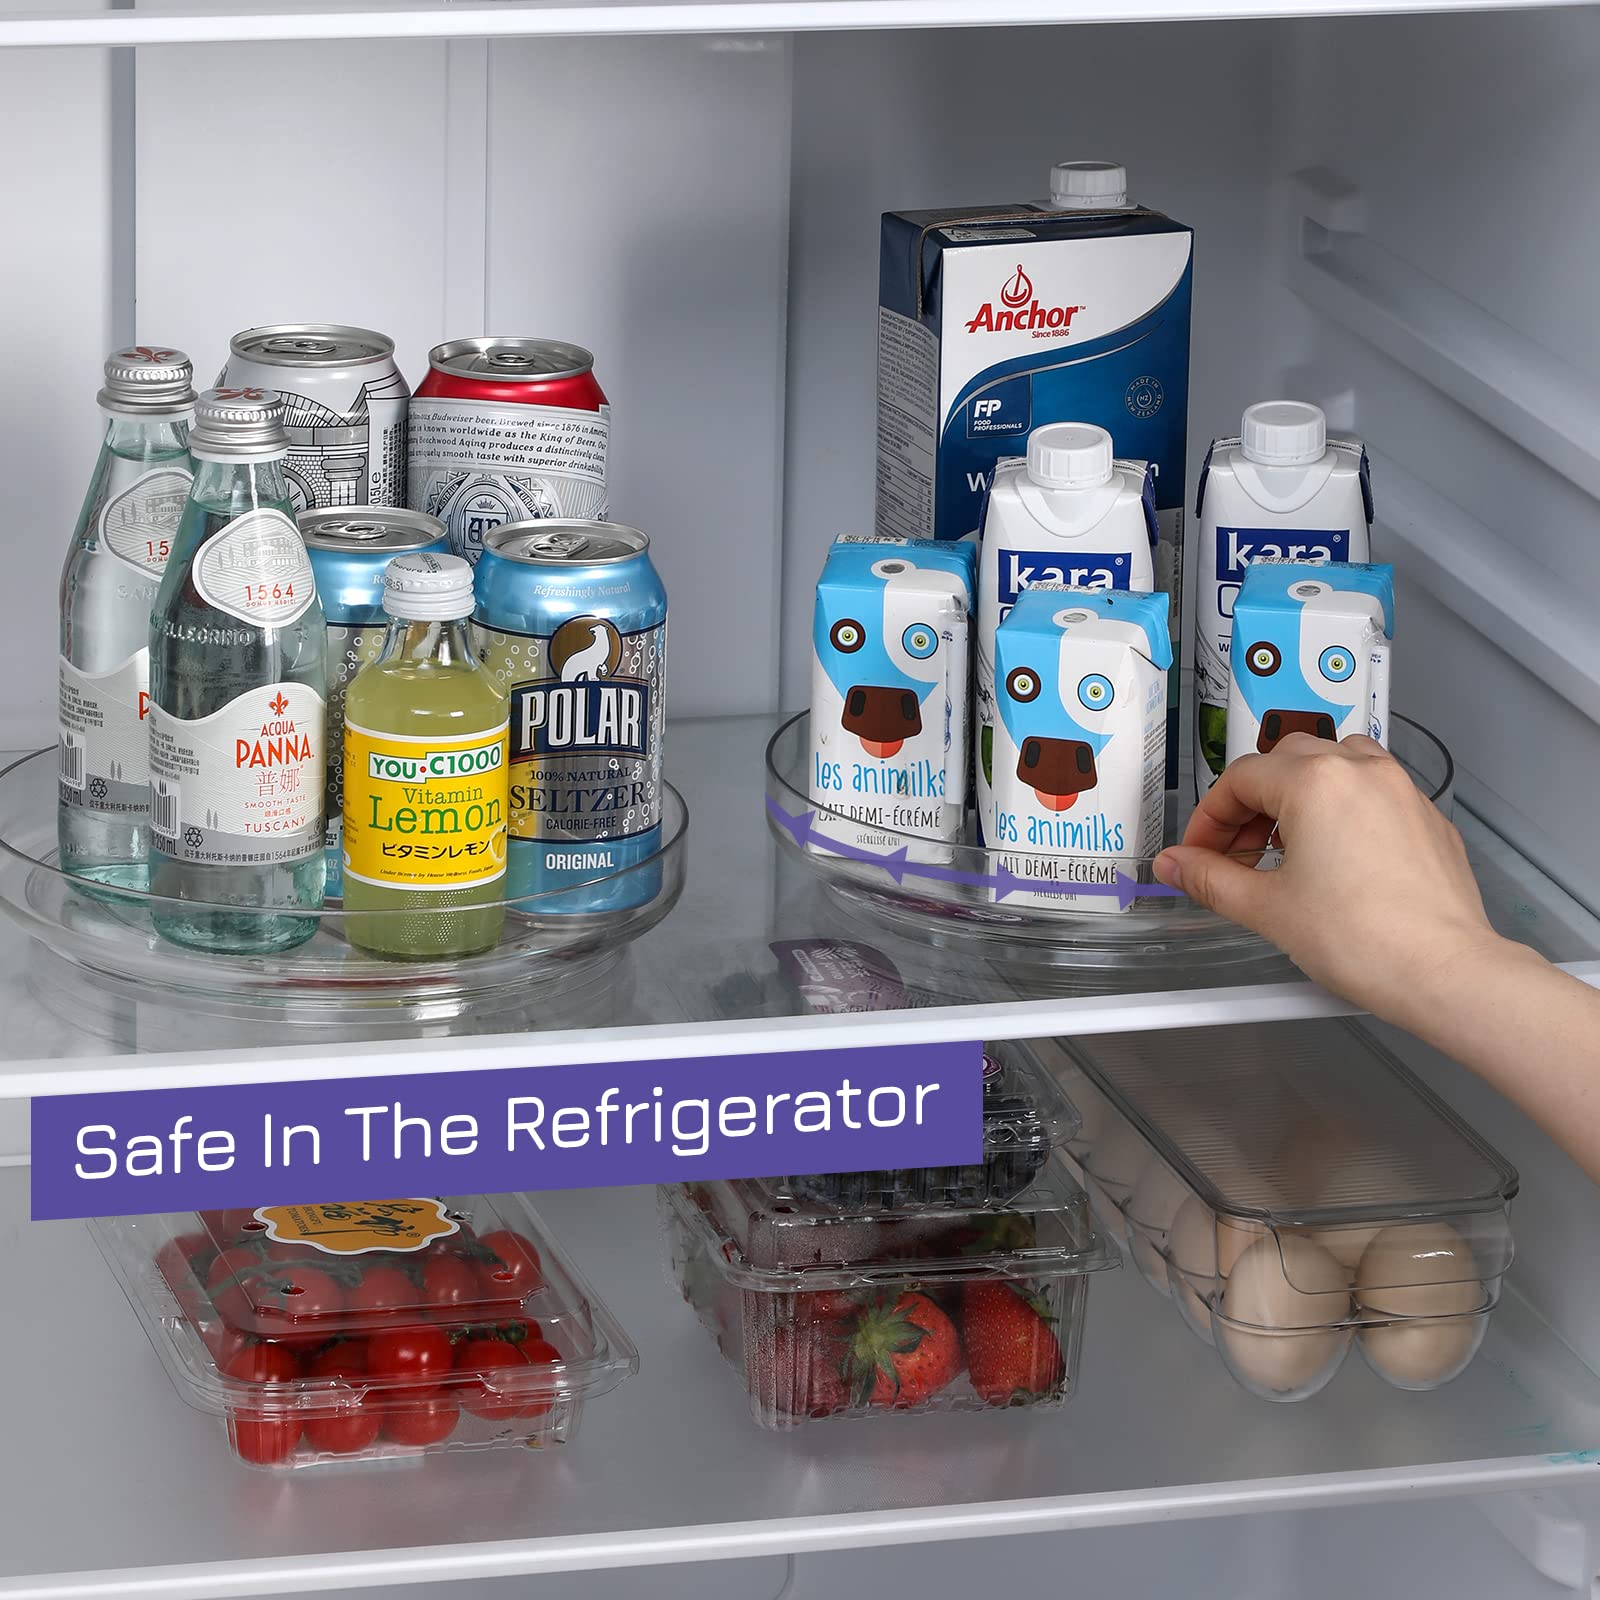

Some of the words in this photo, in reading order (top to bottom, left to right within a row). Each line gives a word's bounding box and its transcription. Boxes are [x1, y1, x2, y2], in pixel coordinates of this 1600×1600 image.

[974, 400, 1002, 417] FP
[432, 413, 473, 422] Budweiser
[475, 416, 497, 425] beer.
[561, 424, 580, 432] 1876
[581, 425, 588, 433] in
[974, 423, 1022, 431] PROFESSIONALS
[423, 424, 447, 433] known
[450, 426, 501, 437] worldwide
[520, 431, 537, 440] the
[540, 433, 562, 443] King
[565, 436, 575, 445] of
[576, 437, 596, 448] Beers.
[419, 437, 456, 445] Beechwood
[459, 438, 486, 448] Aging
[489, 442, 534, 452] produces
[545, 445, 592, 459] distinctively
[476, 452, 501, 461] taste
[503, 454, 525, 463] with
[528, 457, 567, 466] superior
[517, 490, 538, 516] EUROPE
[146, 541, 169, 556] 15
[1008, 555, 1114, 594] kara
[245, 584, 294, 601] 1564
[533, 584, 594, 598] Refreshingly
[598, 581, 631, 596] Natural
[261, 720, 295, 737] ACQUA
[520, 687, 642, 751] POLAR
[236, 732, 311, 768] PANNA
[373, 757, 416, 779] YOU
[429, 746, 500, 775] C1000
[254, 768, 301, 797] 普娜
[531, 770, 563, 782] 100%
[567, 767, 632, 782] NATURAL
[816, 752, 842, 791] les
[853, 759, 945, 798] animilks
[245, 800, 283, 809] SMOOTH
[286, 794, 306, 804] TASTE
[402, 786, 483, 805] Vitamin
[510, 781, 646, 813] SELTZER
[245, 815, 306, 833] TUSCANY
[369, 795, 501, 834] Lemon
[546, 816, 617, 830] CALORIE-FREE
[850, 804, 940, 828] DEMI-ÉCRÉMÉ
[996, 801, 1018, 842] les
[1027, 813, 1124, 852] animilks
[383, 840, 490, 860] ビタミンレモン
[545, 852, 614, 870] ORIGINAL
[1026, 858, 1117, 885] DEMI-ÉCRÉMÉ
